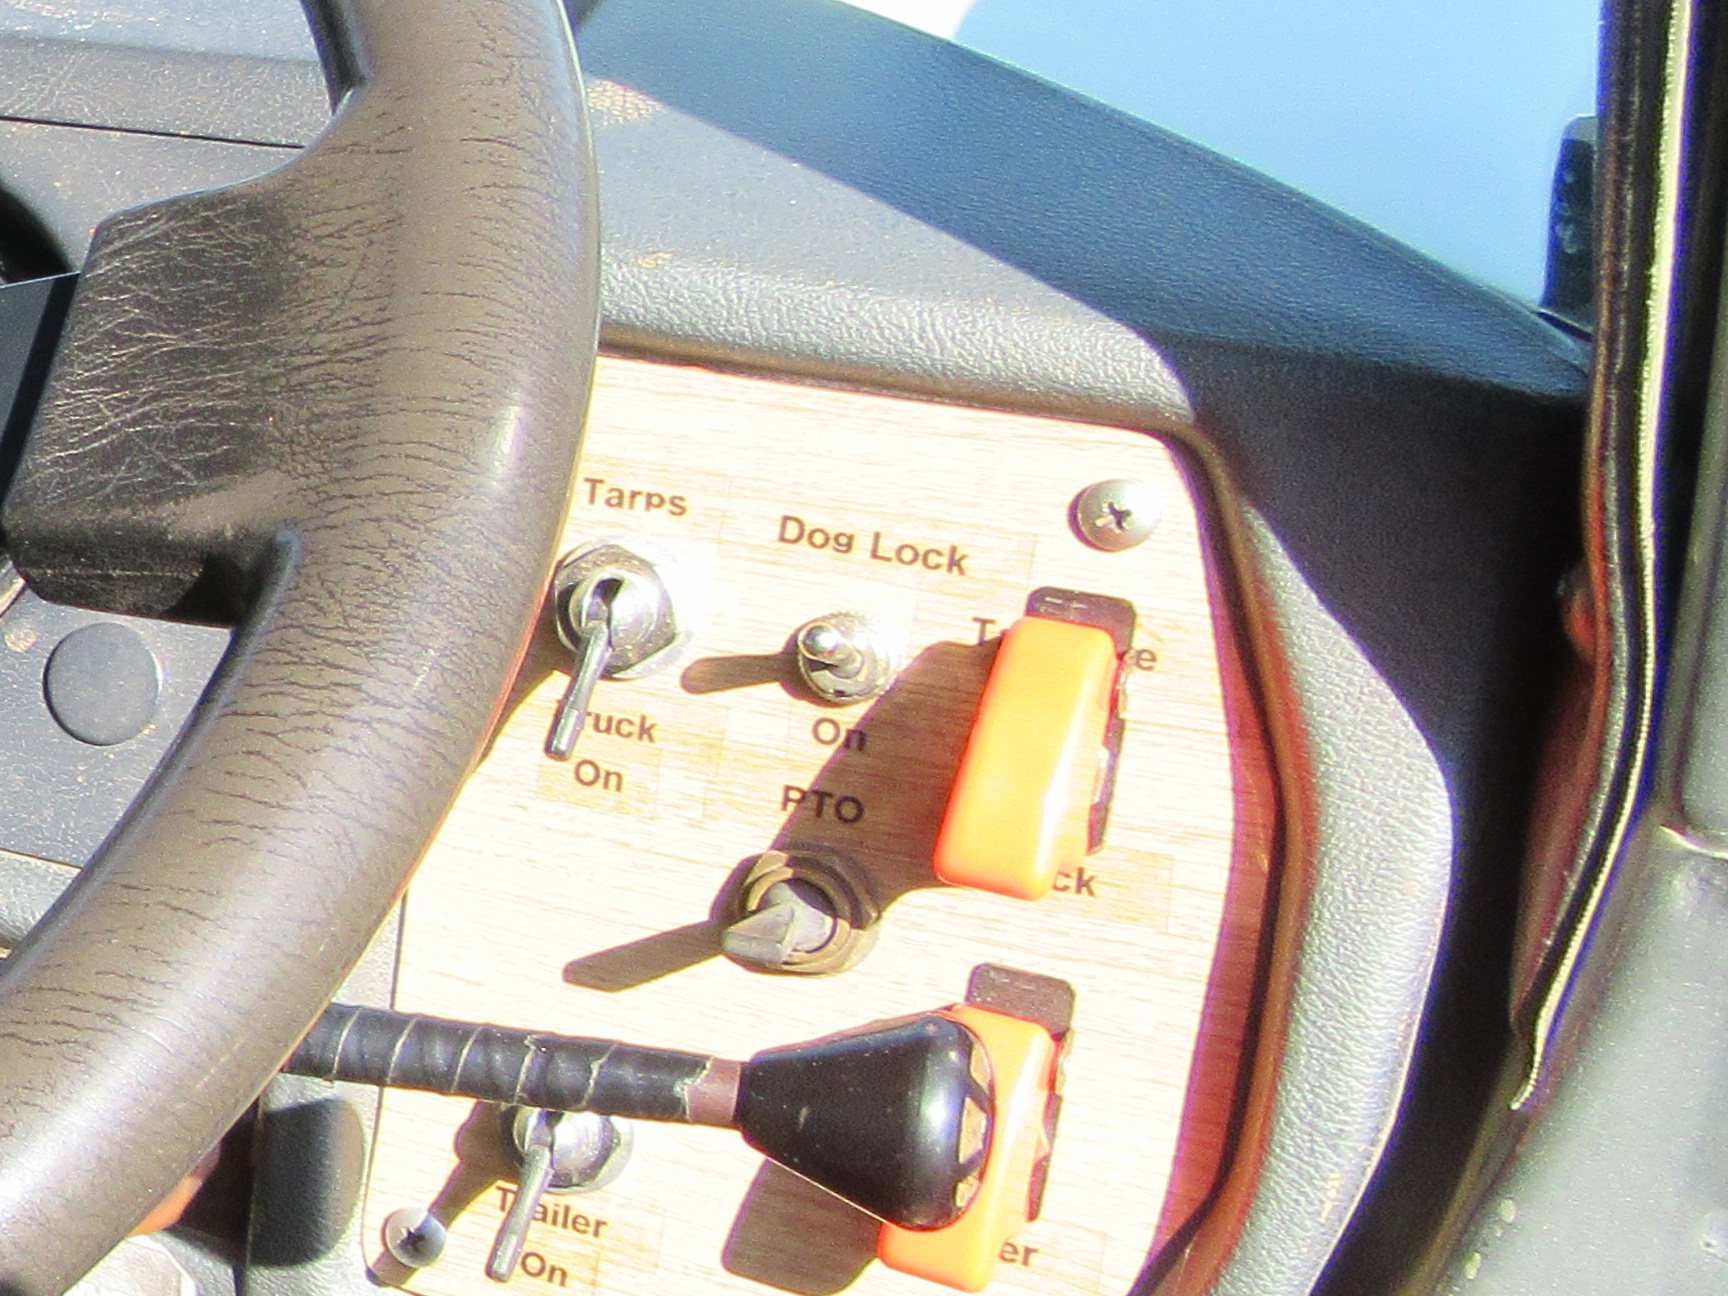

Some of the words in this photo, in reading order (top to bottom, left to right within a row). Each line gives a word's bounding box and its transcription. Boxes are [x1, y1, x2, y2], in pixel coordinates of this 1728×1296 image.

[582, 477, 688, 517] Tarps
[777, 515, 855, 554] Dog
[869, 530, 971, 577] Lock
[811, 717, 867, 753] On
[572, 759, 624, 793] On
[780, 784, 865, 826] PTO
[496, 1184, 609, 1239] Tailer
[520, 1251, 569, 1288] On
